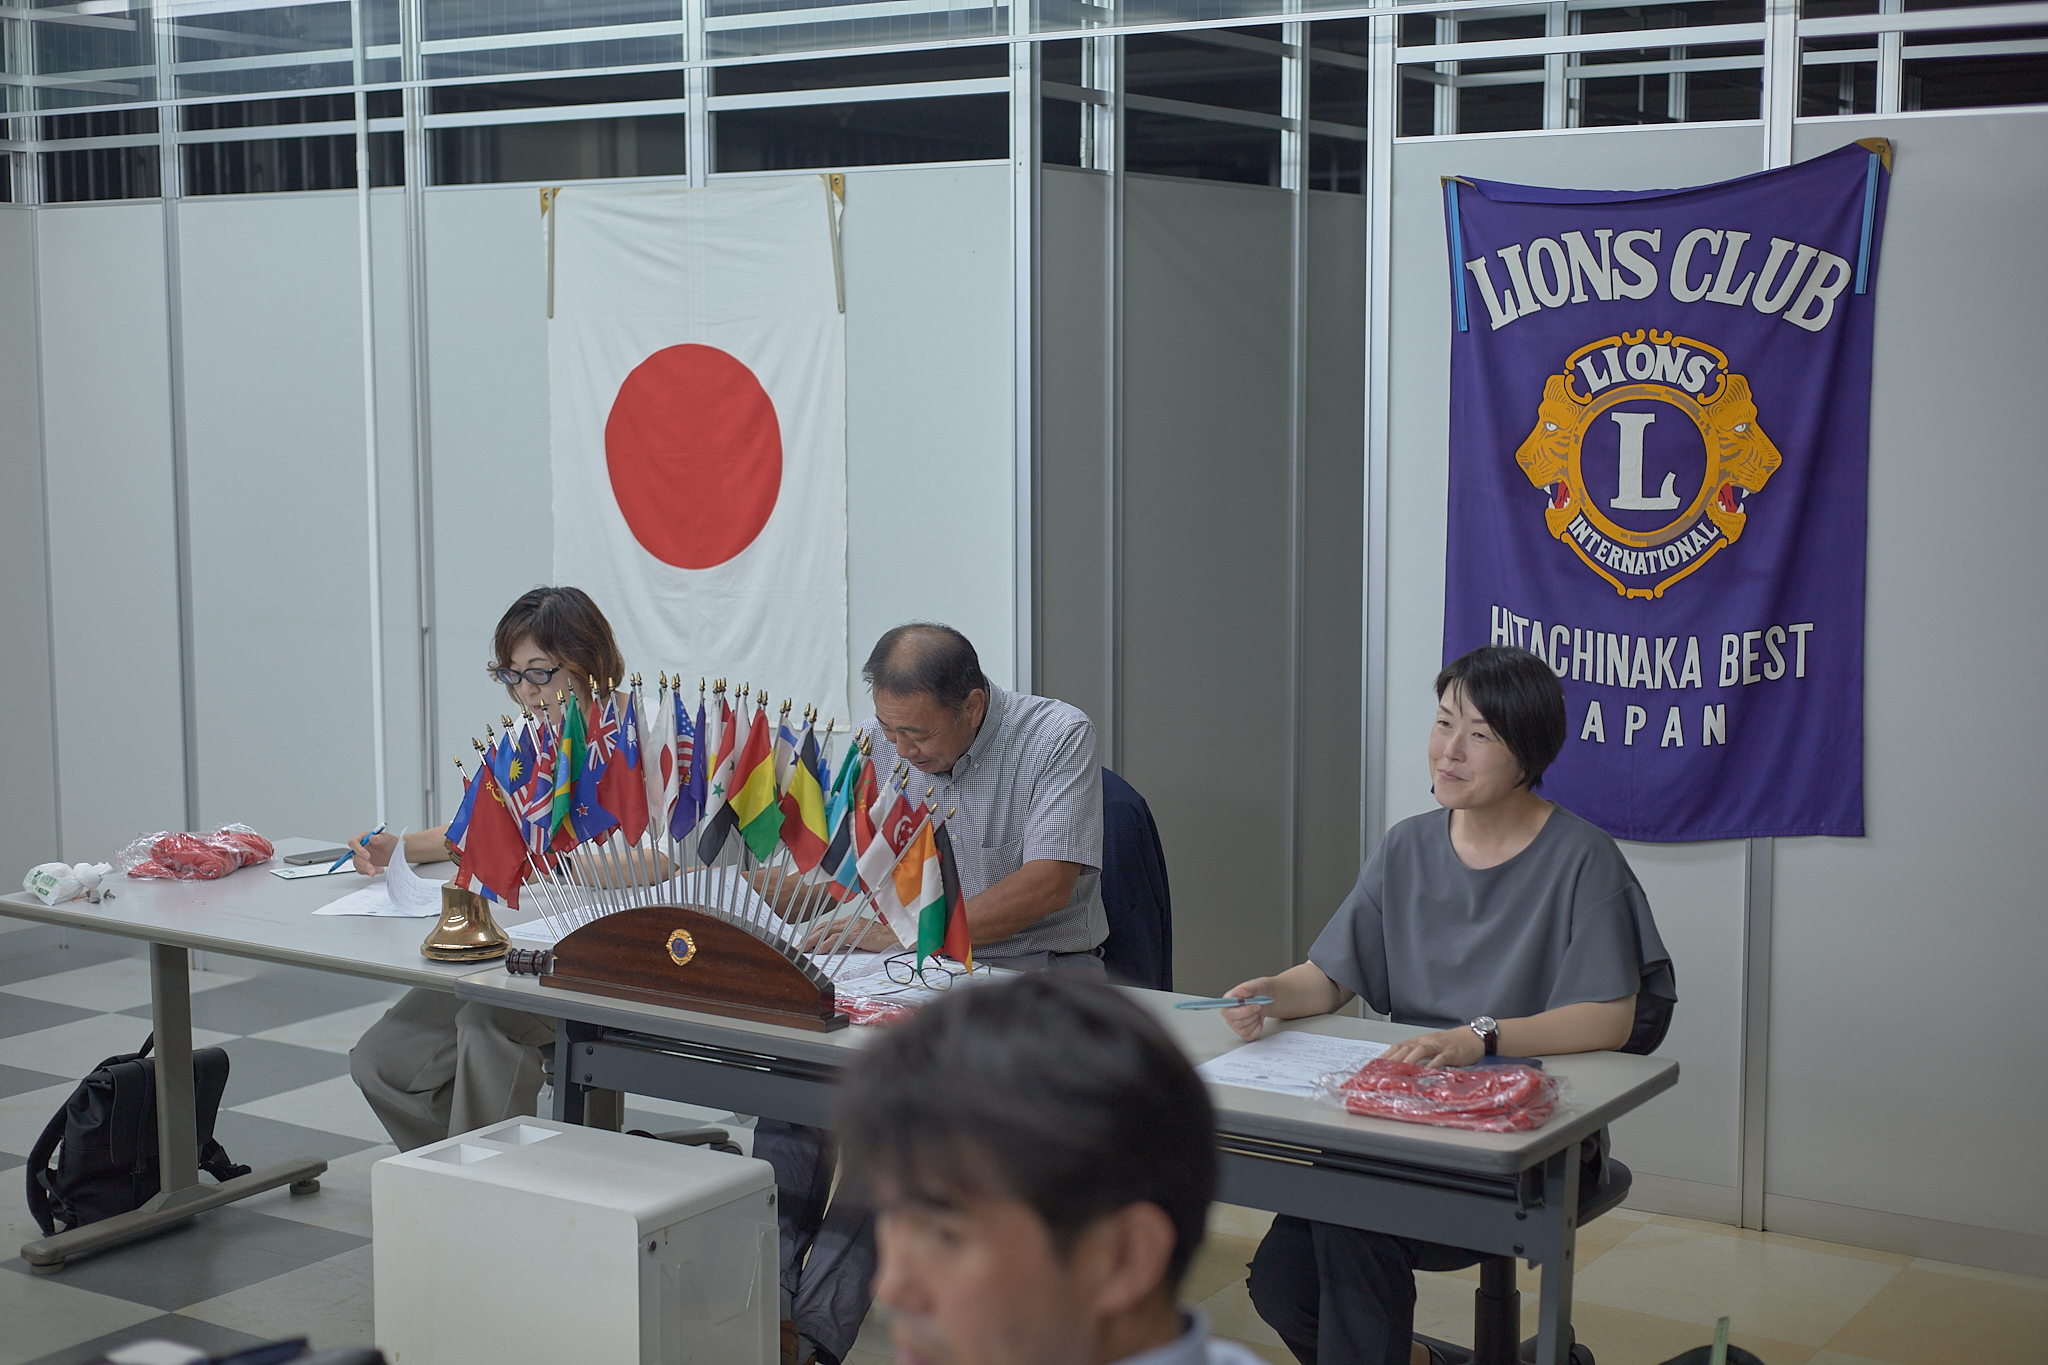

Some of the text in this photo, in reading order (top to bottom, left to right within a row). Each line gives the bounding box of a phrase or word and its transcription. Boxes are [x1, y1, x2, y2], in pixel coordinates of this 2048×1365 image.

[1465, 228, 1852, 332] LIONS CLUB
[1576, 343, 1716, 394] LIONS
[1611, 411, 1681, 510] L
[1568, 514, 1720, 575] INTERNATIONAL
[1490, 604, 1814, 689] HITACHINAKA BEST
[1578, 700, 1727, 748] APAN
